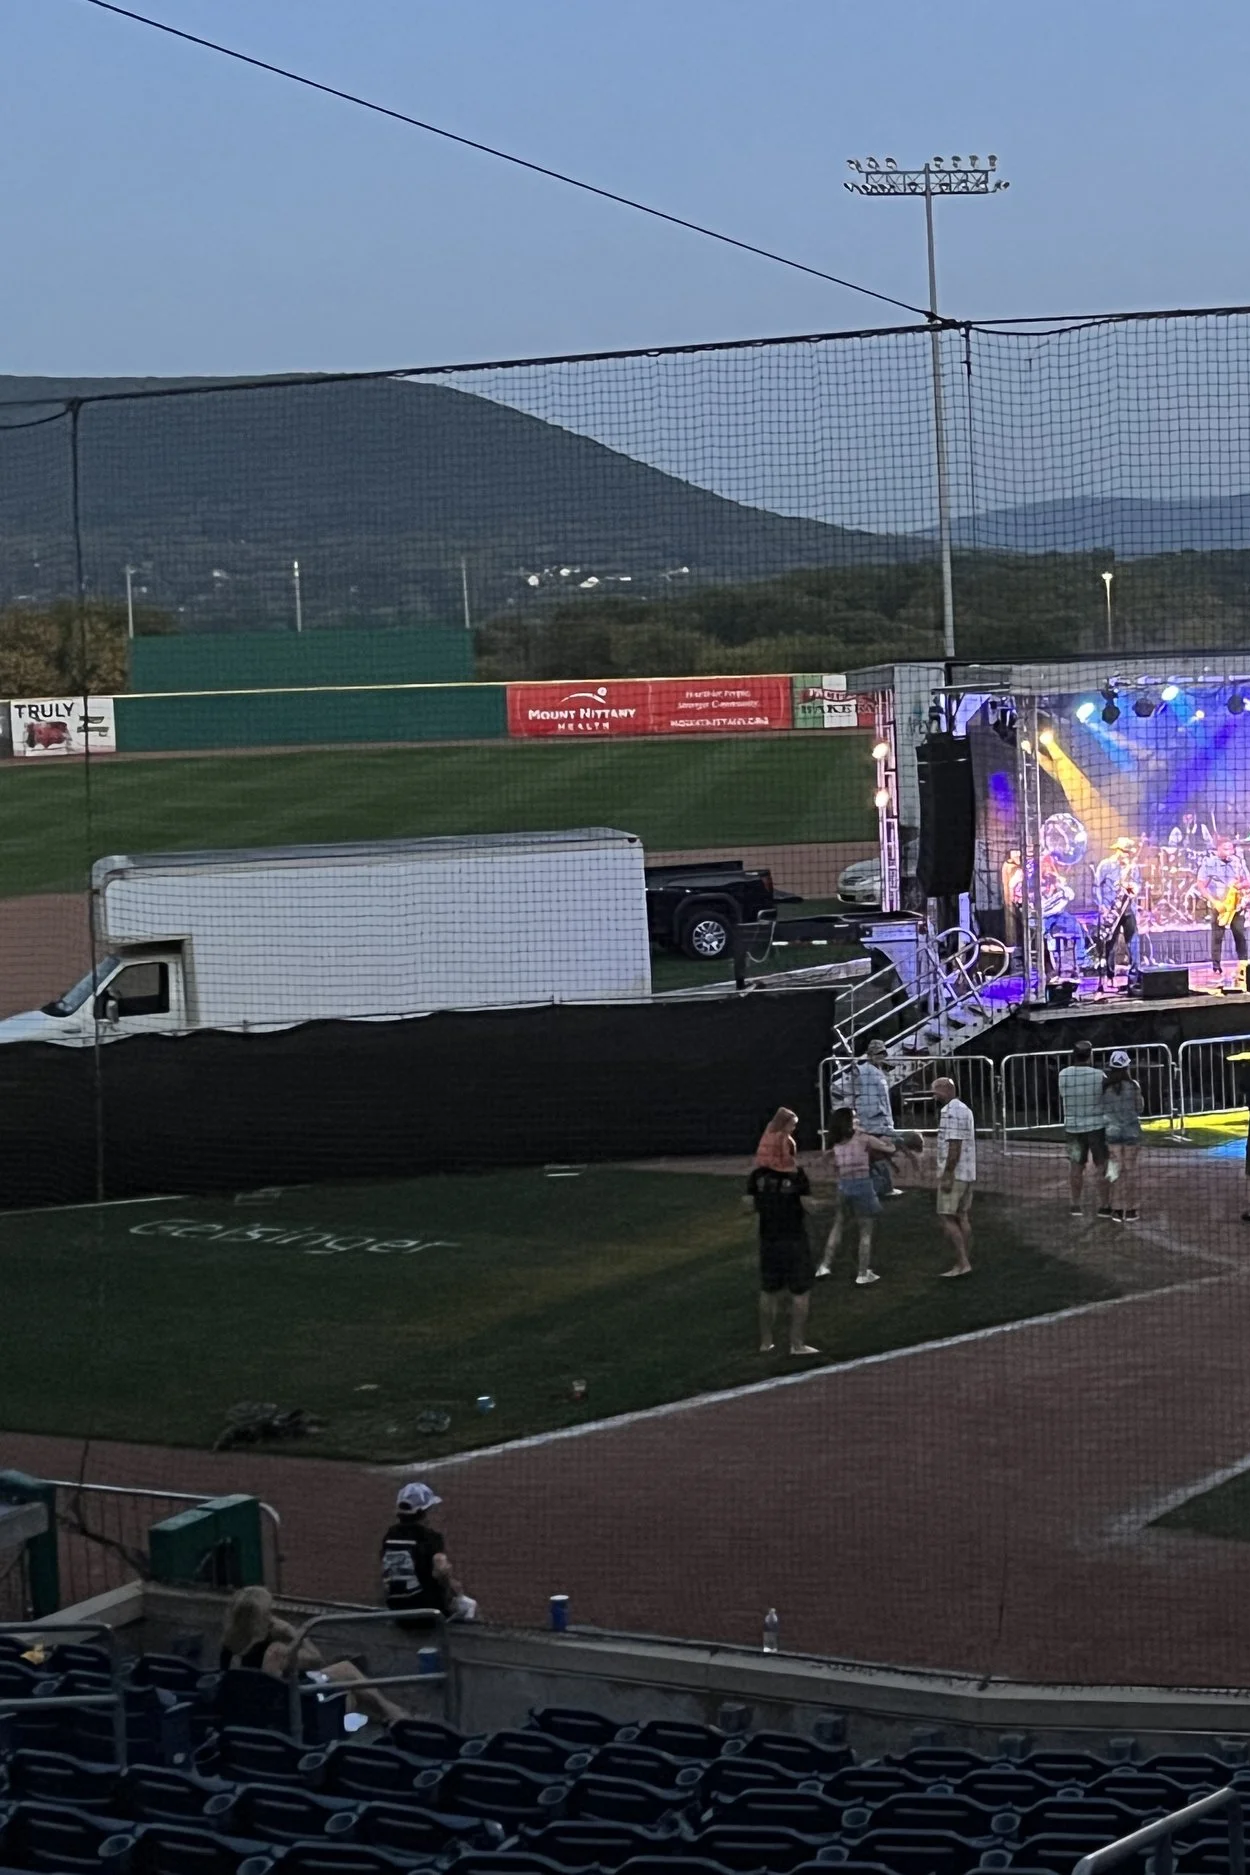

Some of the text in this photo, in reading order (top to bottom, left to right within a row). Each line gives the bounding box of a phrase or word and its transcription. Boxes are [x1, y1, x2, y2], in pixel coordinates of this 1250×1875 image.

[14, 702, 75, 722] TRULY
[528, 707, 637, 721] MOUNT NITTANY
[557, 722, 610, 731] HEALTH
[129, 1219, 462, 1255] Geisinger
